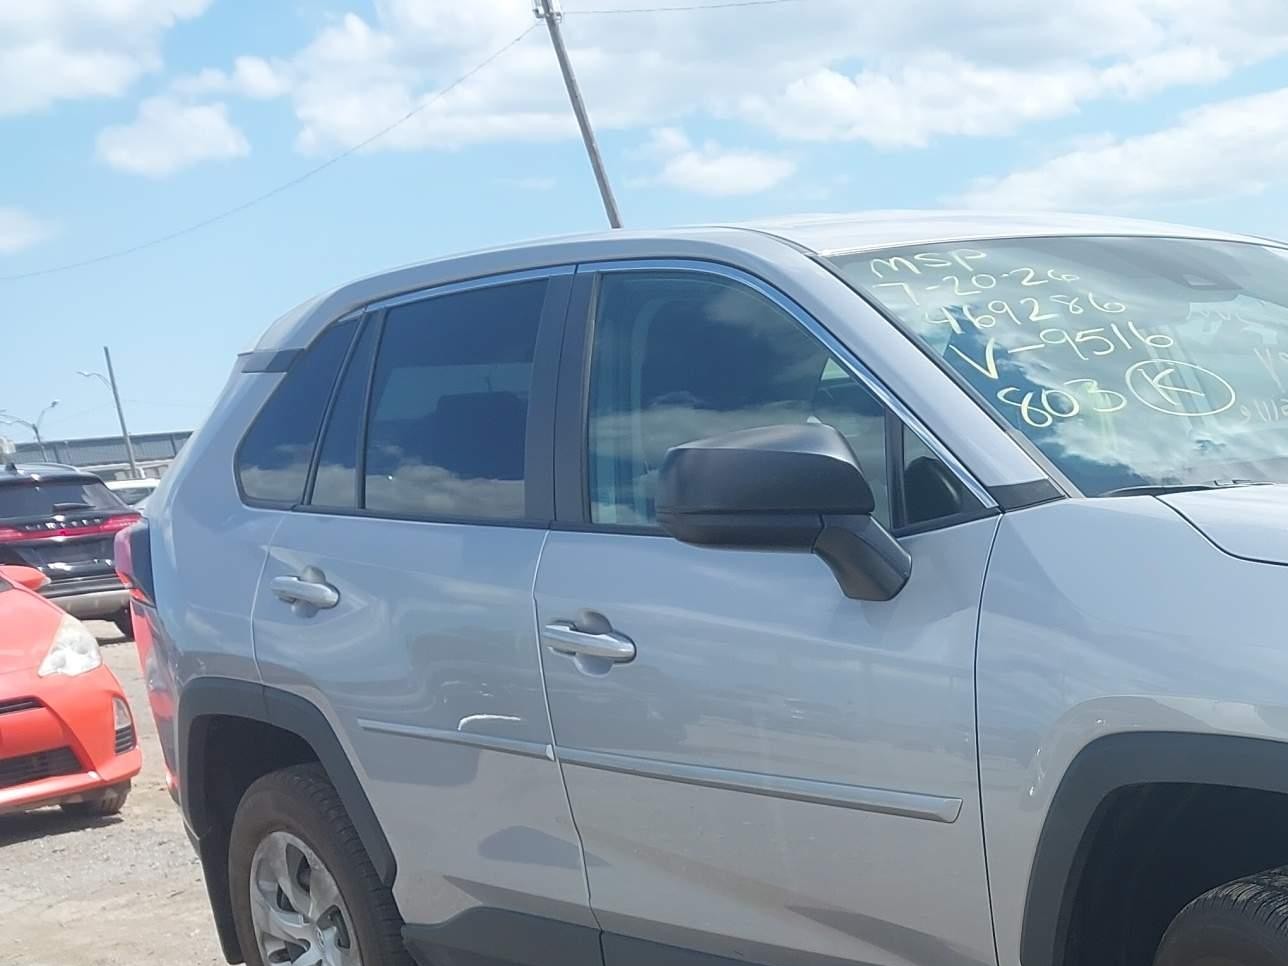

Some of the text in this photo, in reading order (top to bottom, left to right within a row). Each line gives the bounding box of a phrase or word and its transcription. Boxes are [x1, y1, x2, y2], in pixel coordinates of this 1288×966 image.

[870, 248, 987, 279] MSP
[872, 267, 1081, 306] 7-20-26
[925, 291, 1127, 335] 469286
[997, 367, 1205, 428] 803 K
